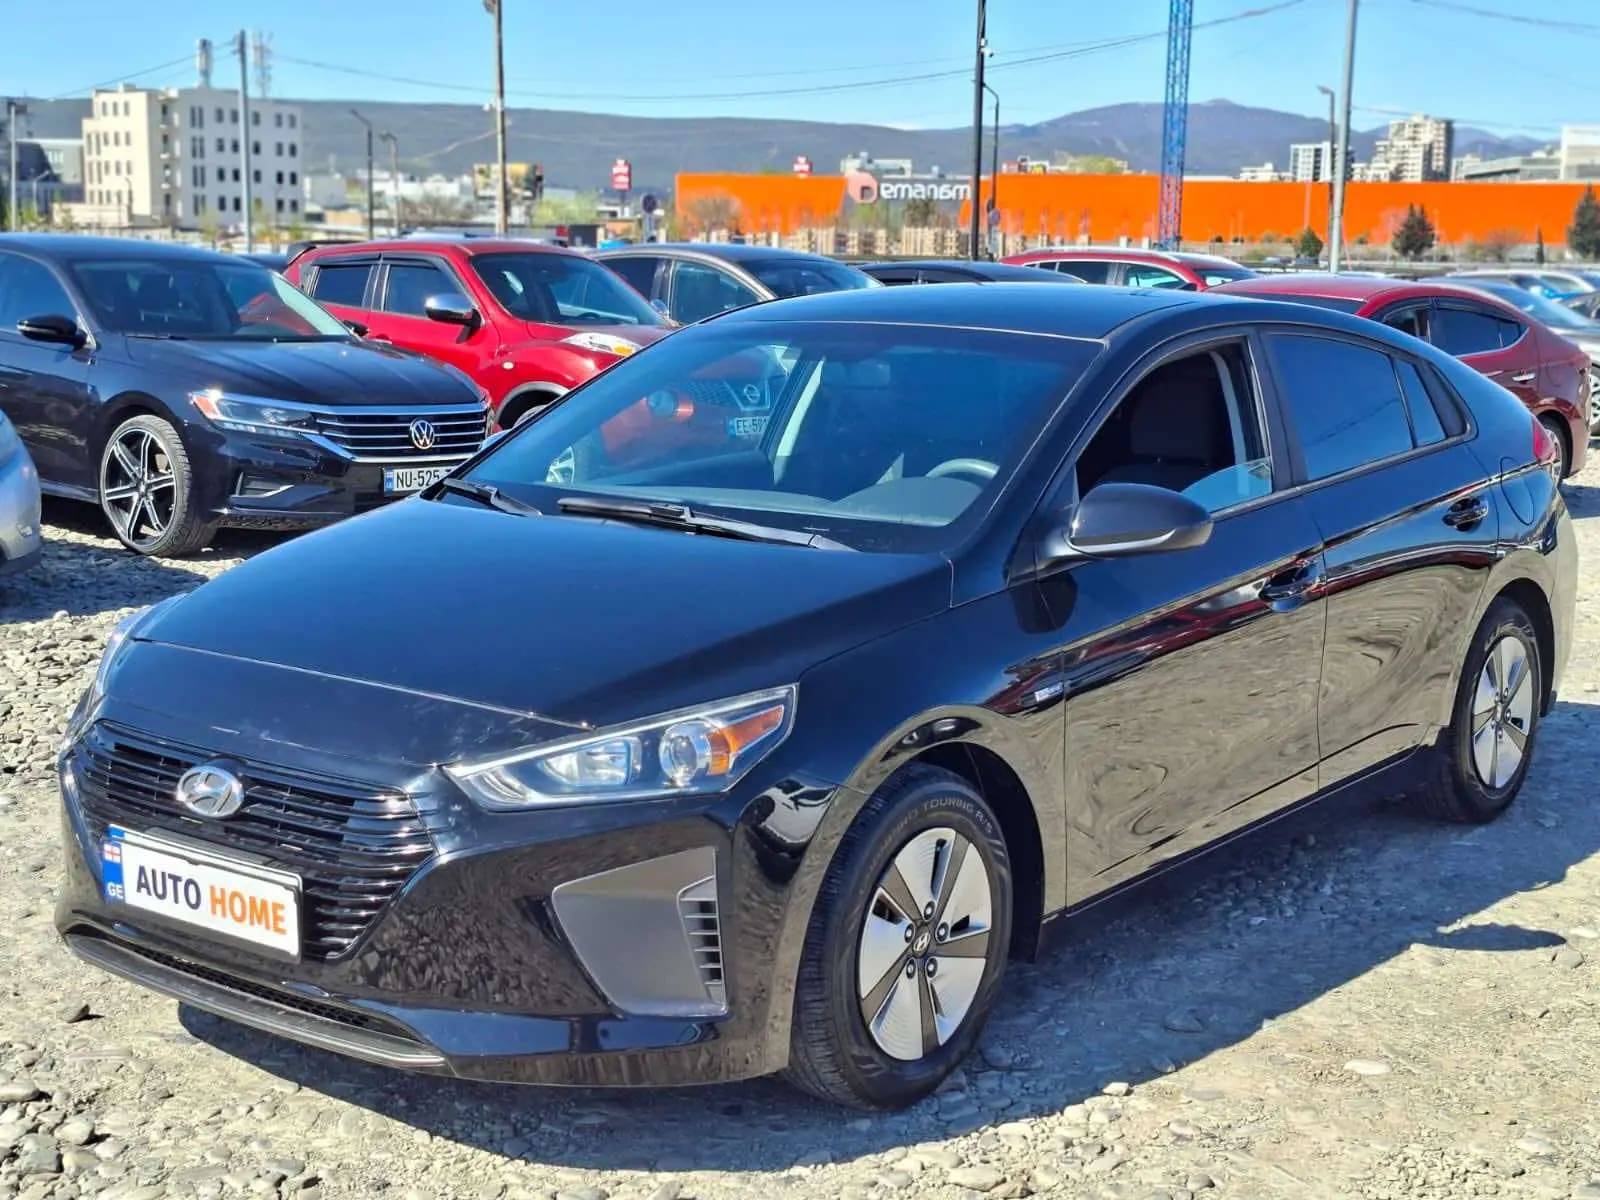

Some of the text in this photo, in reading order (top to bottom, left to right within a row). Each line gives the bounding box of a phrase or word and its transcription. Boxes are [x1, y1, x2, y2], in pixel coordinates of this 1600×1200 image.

[106, 881, 124, 900] GE
[136, 865, 287, 936] AUTO HOME
